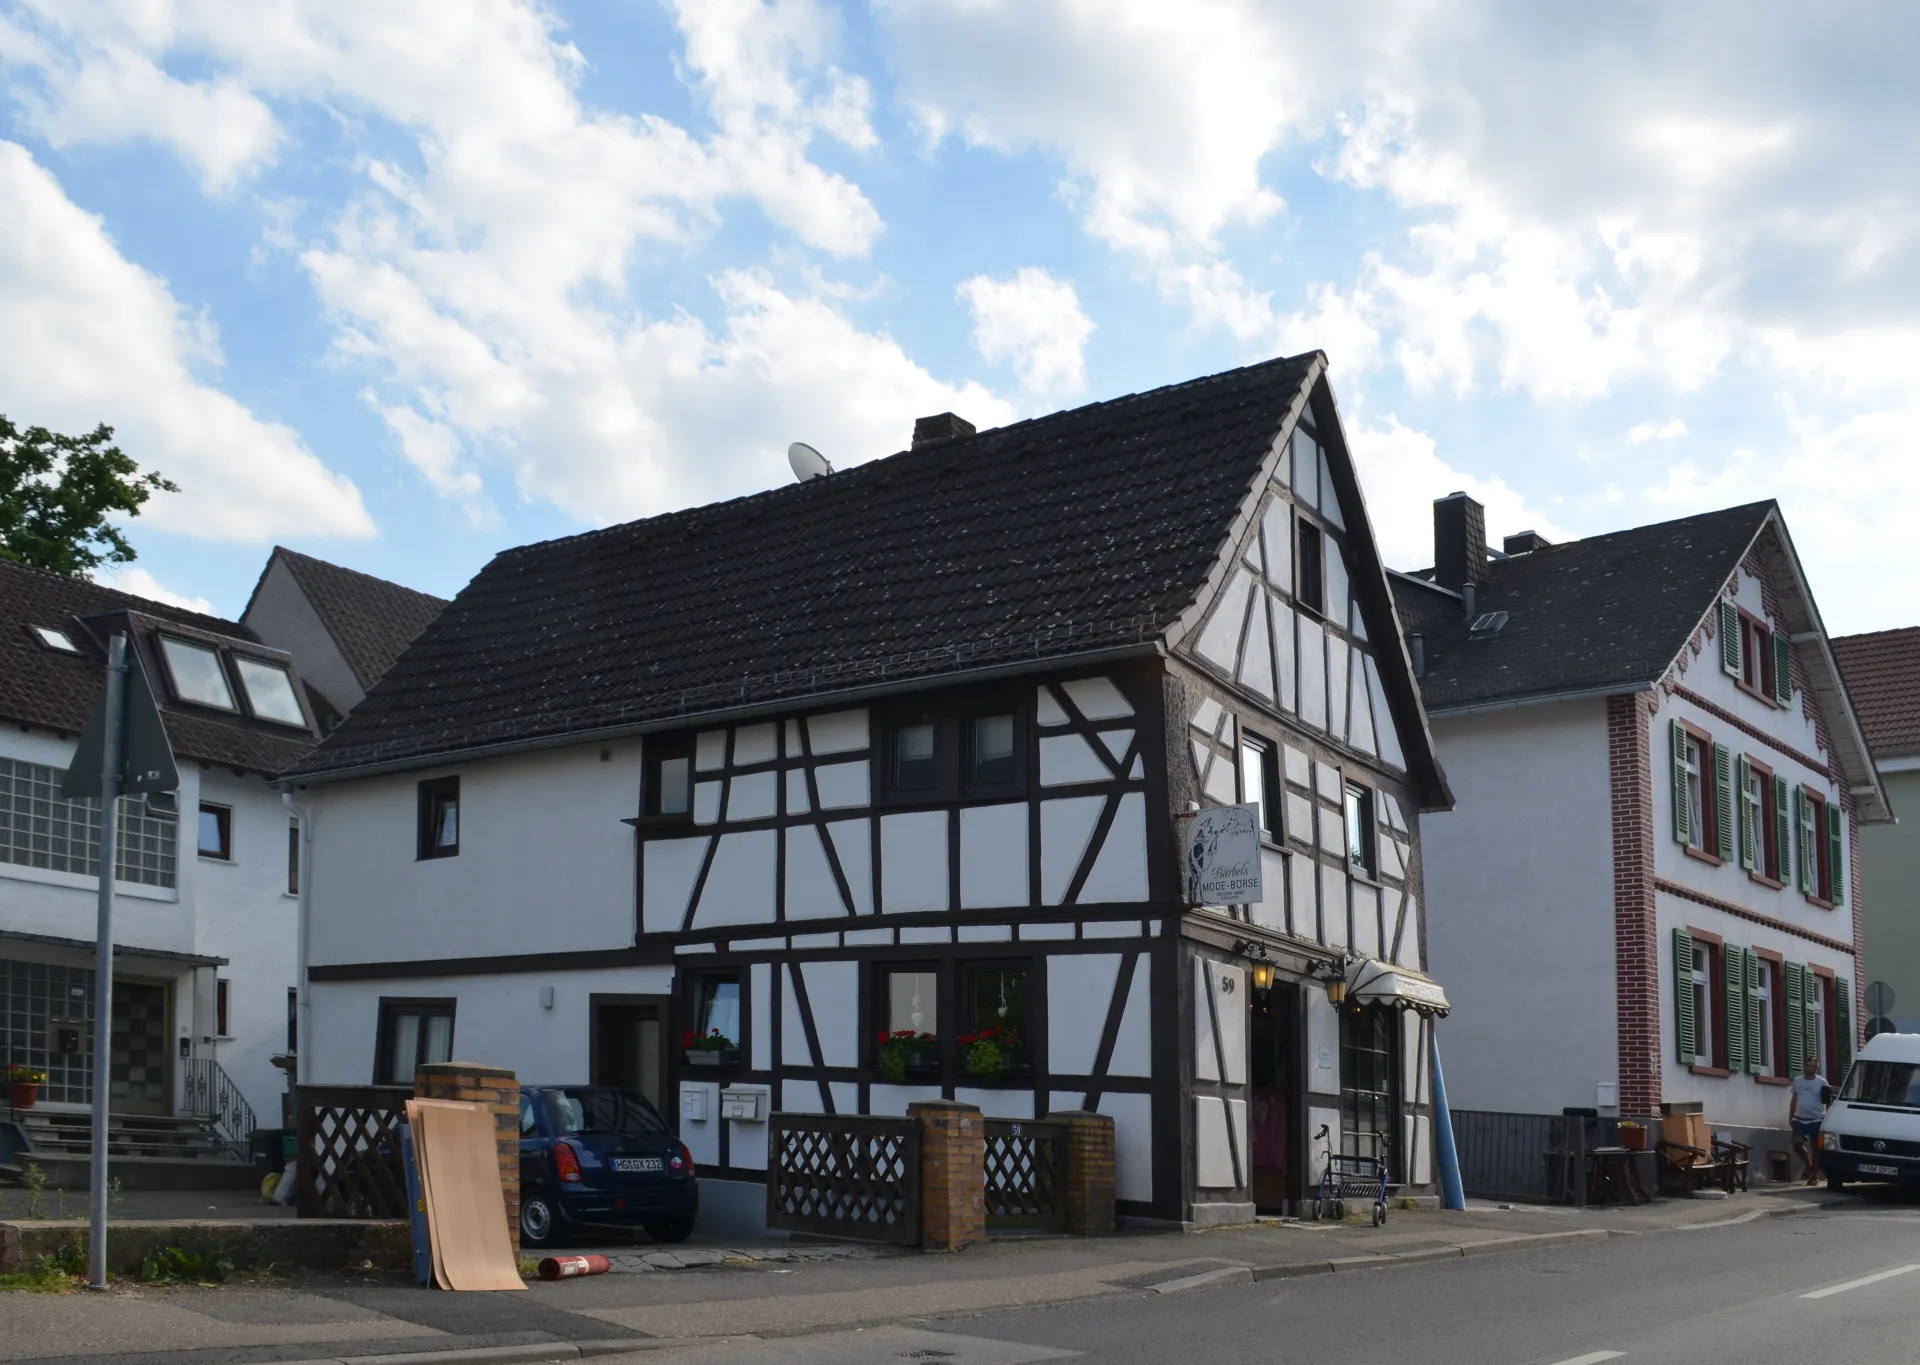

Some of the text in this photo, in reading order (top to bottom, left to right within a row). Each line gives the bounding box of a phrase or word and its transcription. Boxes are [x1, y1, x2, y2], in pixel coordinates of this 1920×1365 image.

[1211, 861, 1250, 879] Bärbels
[1202, 878, 1259, 892] MODE-BÖRSE
[1222, 976, 1235, 994] 59
[1013, 1125, 1020, 1135] 59
[645, 1159, 663, 1169] 232
